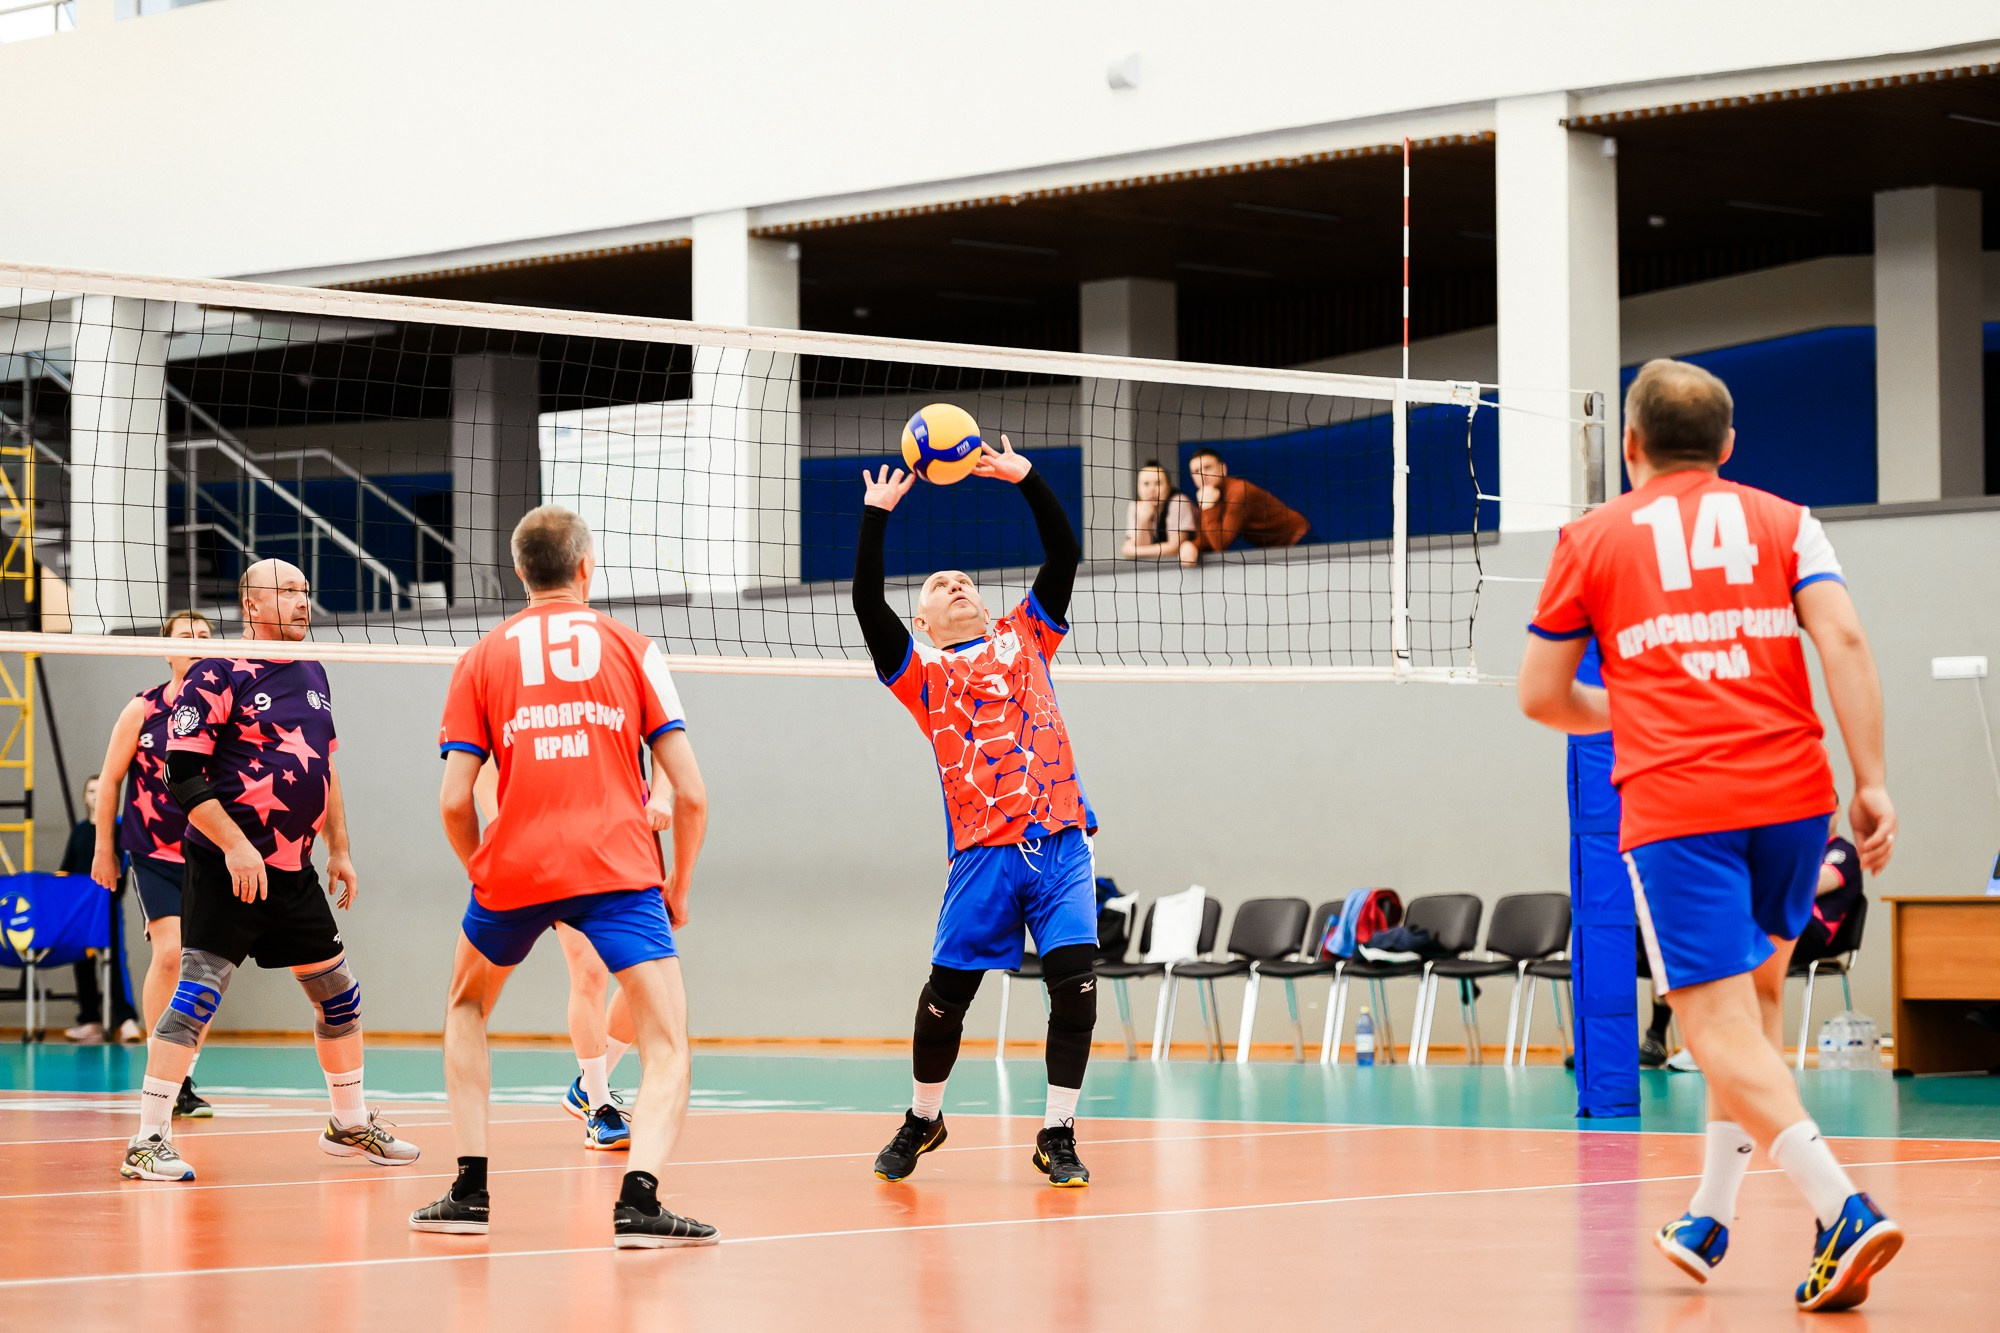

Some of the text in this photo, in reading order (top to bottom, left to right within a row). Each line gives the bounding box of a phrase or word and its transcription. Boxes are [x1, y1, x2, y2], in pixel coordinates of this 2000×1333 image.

[1631, 492, 1759, 592] 14
[505, 611, 601, 686] 15
[254, 693, 271, 711] 9
[140, 733, 154, 748] 8
[502, 700, 625, 748] КСНОЯРСКИЙ
[533, 729, 589, 760] КРАЙ
